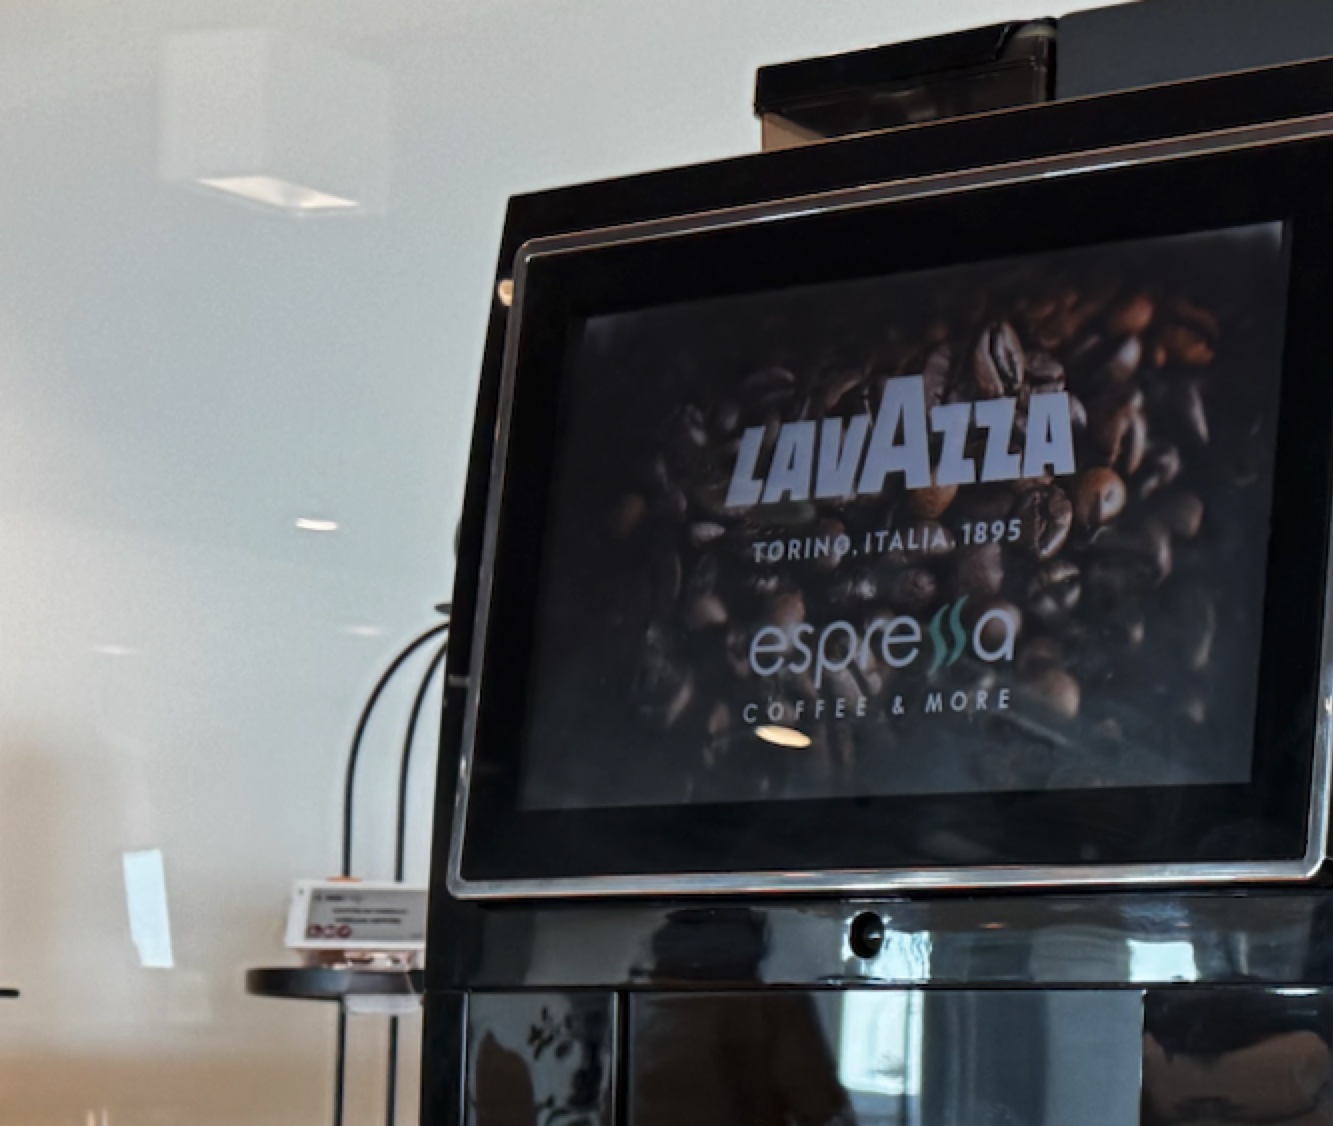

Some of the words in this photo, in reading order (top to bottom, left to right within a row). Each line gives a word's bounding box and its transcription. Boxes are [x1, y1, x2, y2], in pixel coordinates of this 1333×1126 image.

[725, 373, 1076, 507] LAVAZZA
[752, 533, 858, 564] TORINO,
[864, 525, 956, 554] ITALIA,
[961, 518, 1023, 546] 1895
[742, 695, 868, 724] COFFEE
[891, 694, 905, 716] &
[924, 688, 1012, 715] MORE
